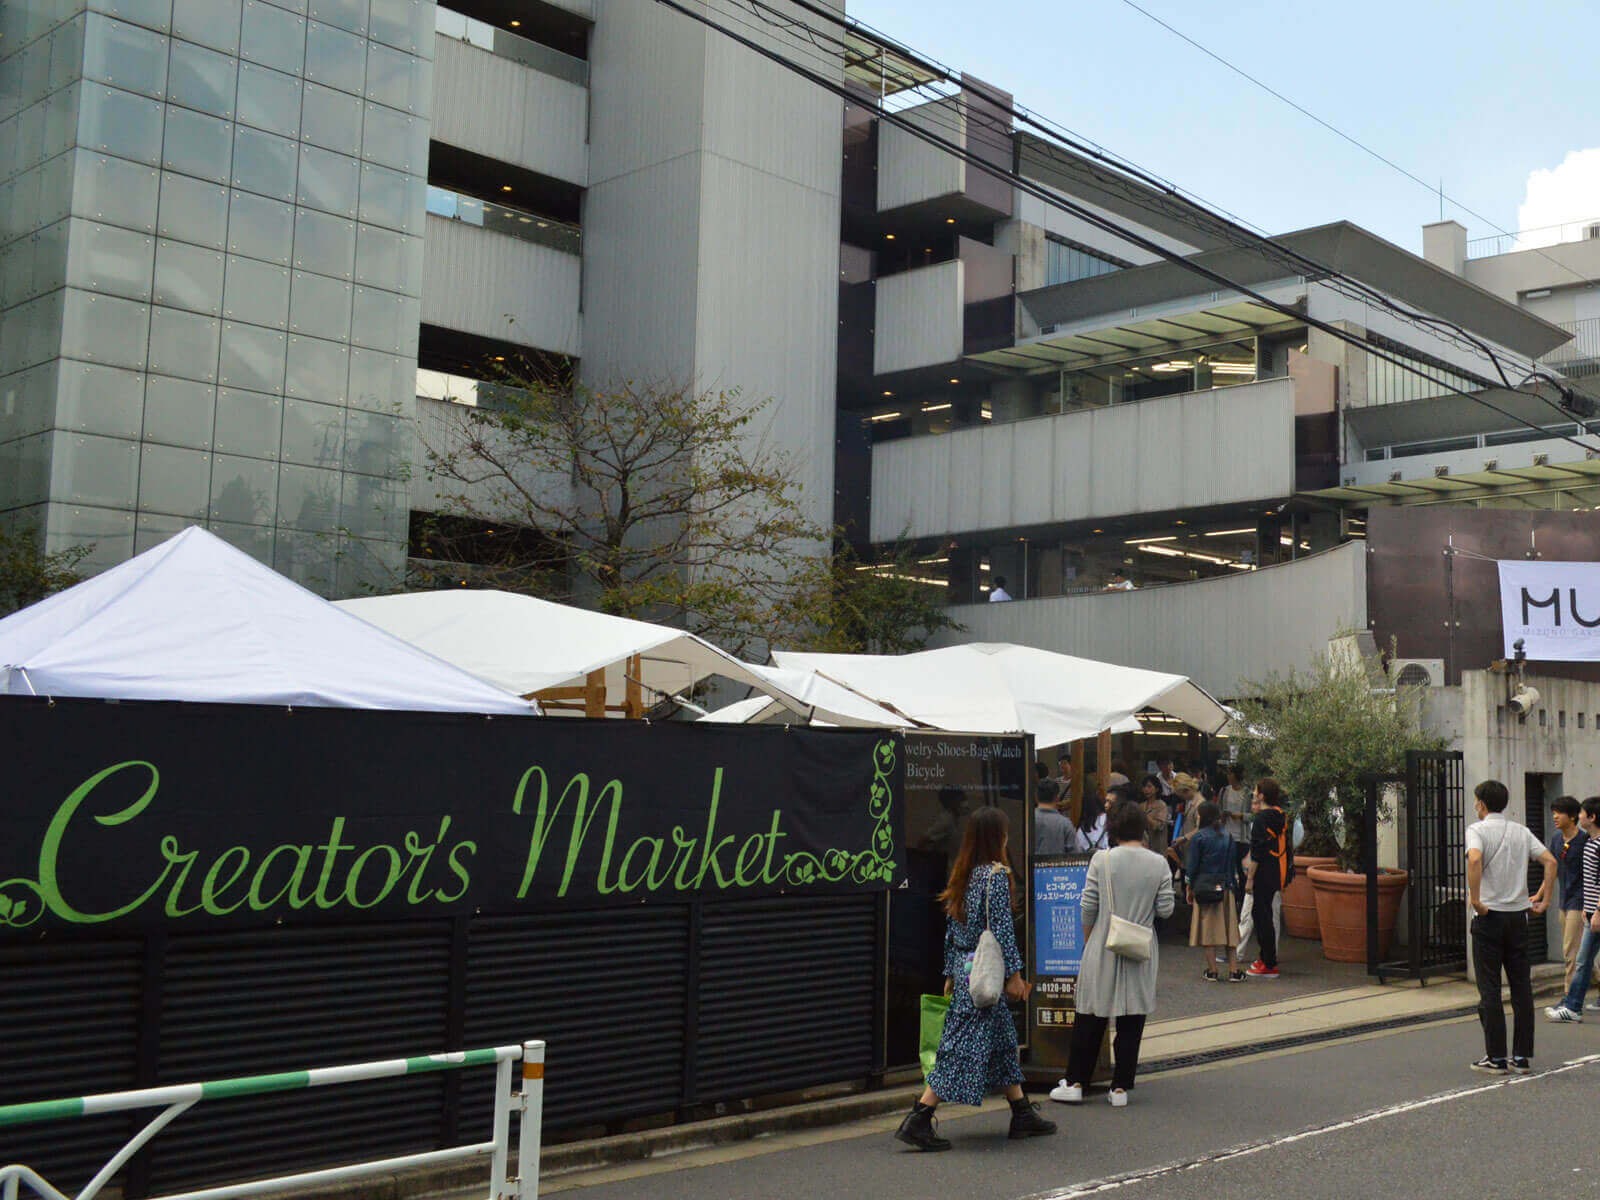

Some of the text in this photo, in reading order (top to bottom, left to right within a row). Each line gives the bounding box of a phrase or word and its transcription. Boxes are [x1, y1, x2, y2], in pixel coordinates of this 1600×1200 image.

[512, 765, 787, 898] Market
[907, 763, 945, 781] Bicycle
[39, 760, 477, 924] Creator's
